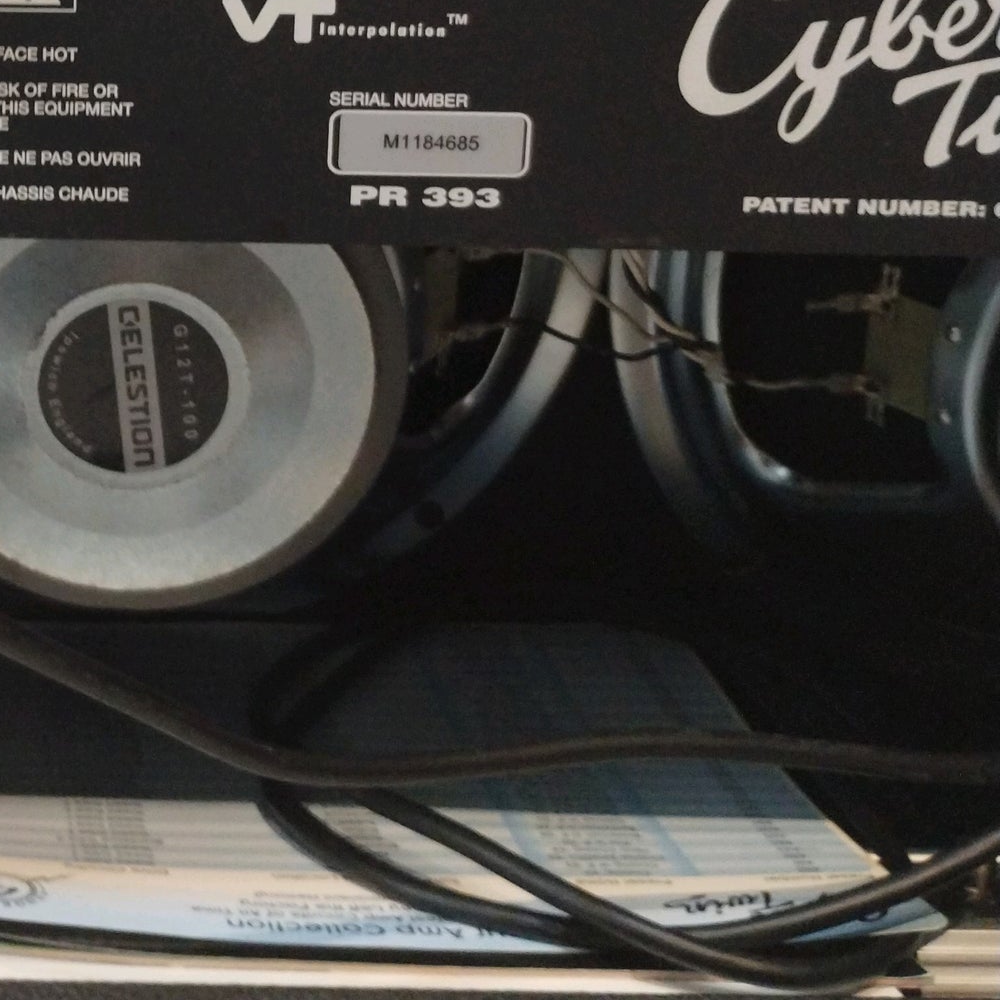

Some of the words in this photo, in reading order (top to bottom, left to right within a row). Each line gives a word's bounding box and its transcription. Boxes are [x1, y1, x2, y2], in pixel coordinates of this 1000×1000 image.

[319, 21, 447, 39] Interpolation
[42, 47, 78, 63] HOT
[24, 82, 48, 98] OF
[52, 82, 90, 98] FIRE
[93, 83, 119, 99] OR
[329, 91, 391, 107] SERIAL
[394, 92, 469, 108] NUMBER
[34, 101, 134, 117] EQUIPMENT
[383, 133, 480, 152] M1184685
[13, 150, 38, 166] NE
[41, 151, 74, 167] PAS
[77, 151, 142, 168] OUVRIR
[58, 186, 130, 203] CHAUDE
[350, 184, 408, 207] PR
[421, 186, 501, 209] 393
[742, 196, 849, 215] PATENT
[856, 198, 987, 219] NUMBER:
